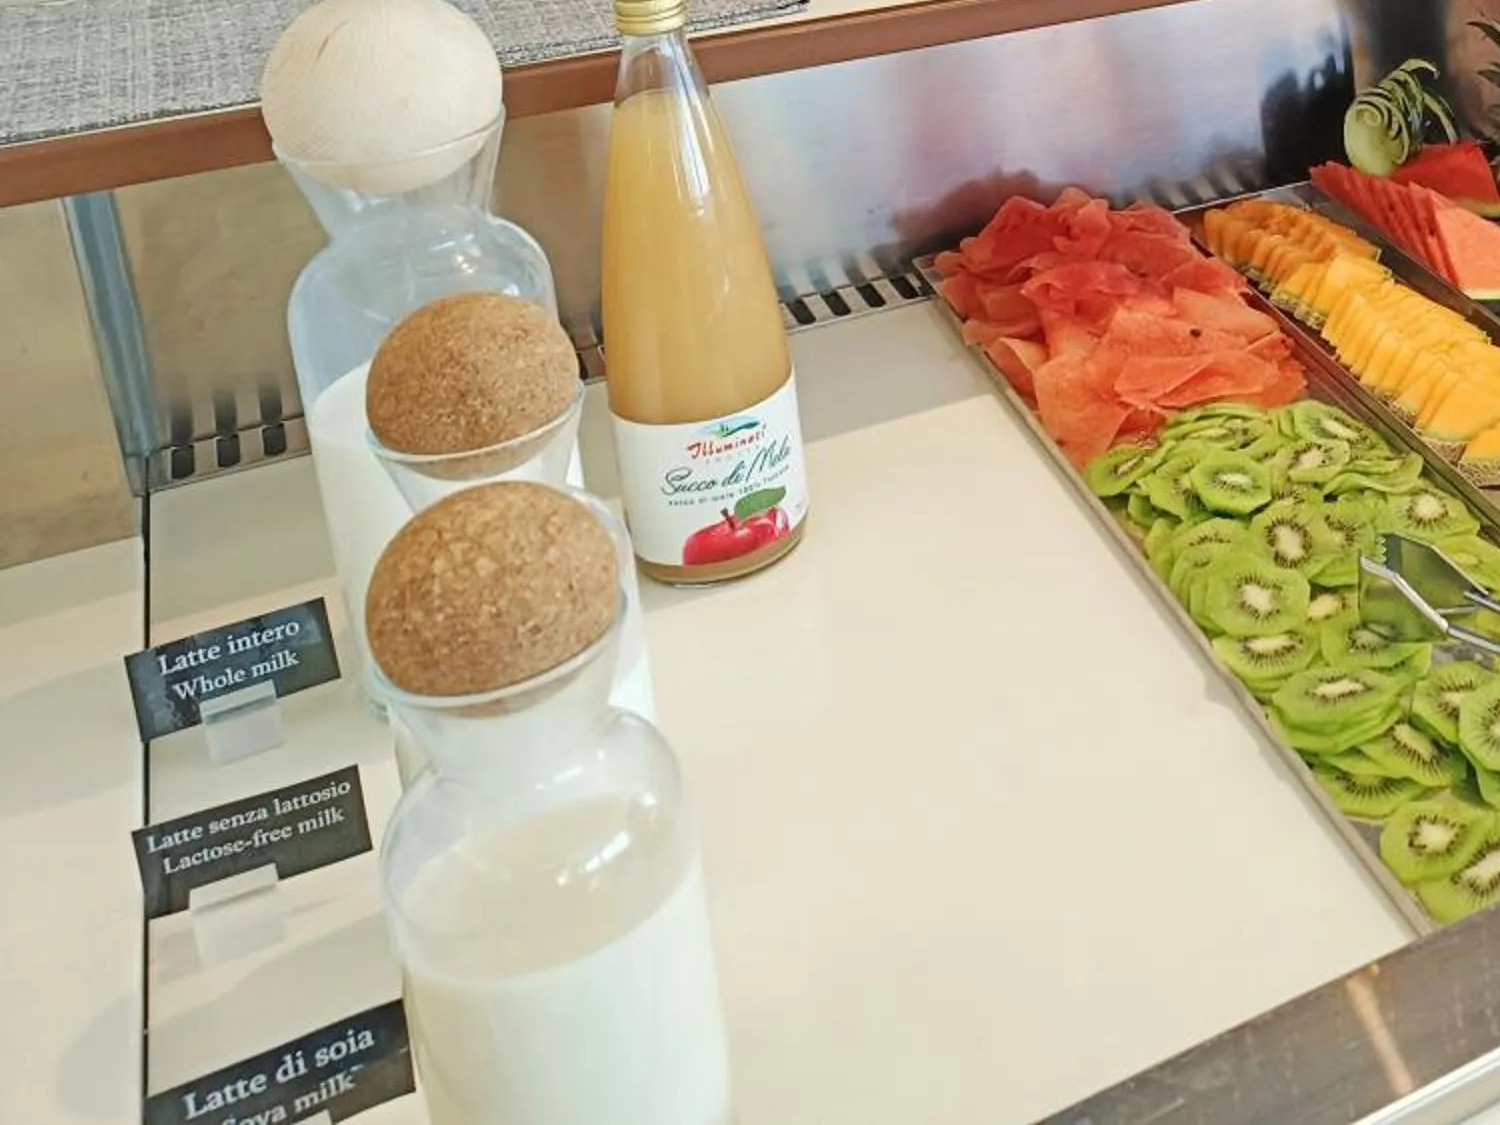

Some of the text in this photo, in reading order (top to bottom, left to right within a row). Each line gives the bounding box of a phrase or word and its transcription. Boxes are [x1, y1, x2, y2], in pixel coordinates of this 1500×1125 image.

[661, 466, 717, 495] Succo
[158, 621, 300, 675] Latte intero
[172, 649, 300, 700] Whole milk
[146, 780, 351, 854] Latte senza lattosio
[163, 806, 346, 875] Lactose-free milk
[181, 1028, 376, 1120] Latte di soia
[292, 1072, 358, 1115] milk
